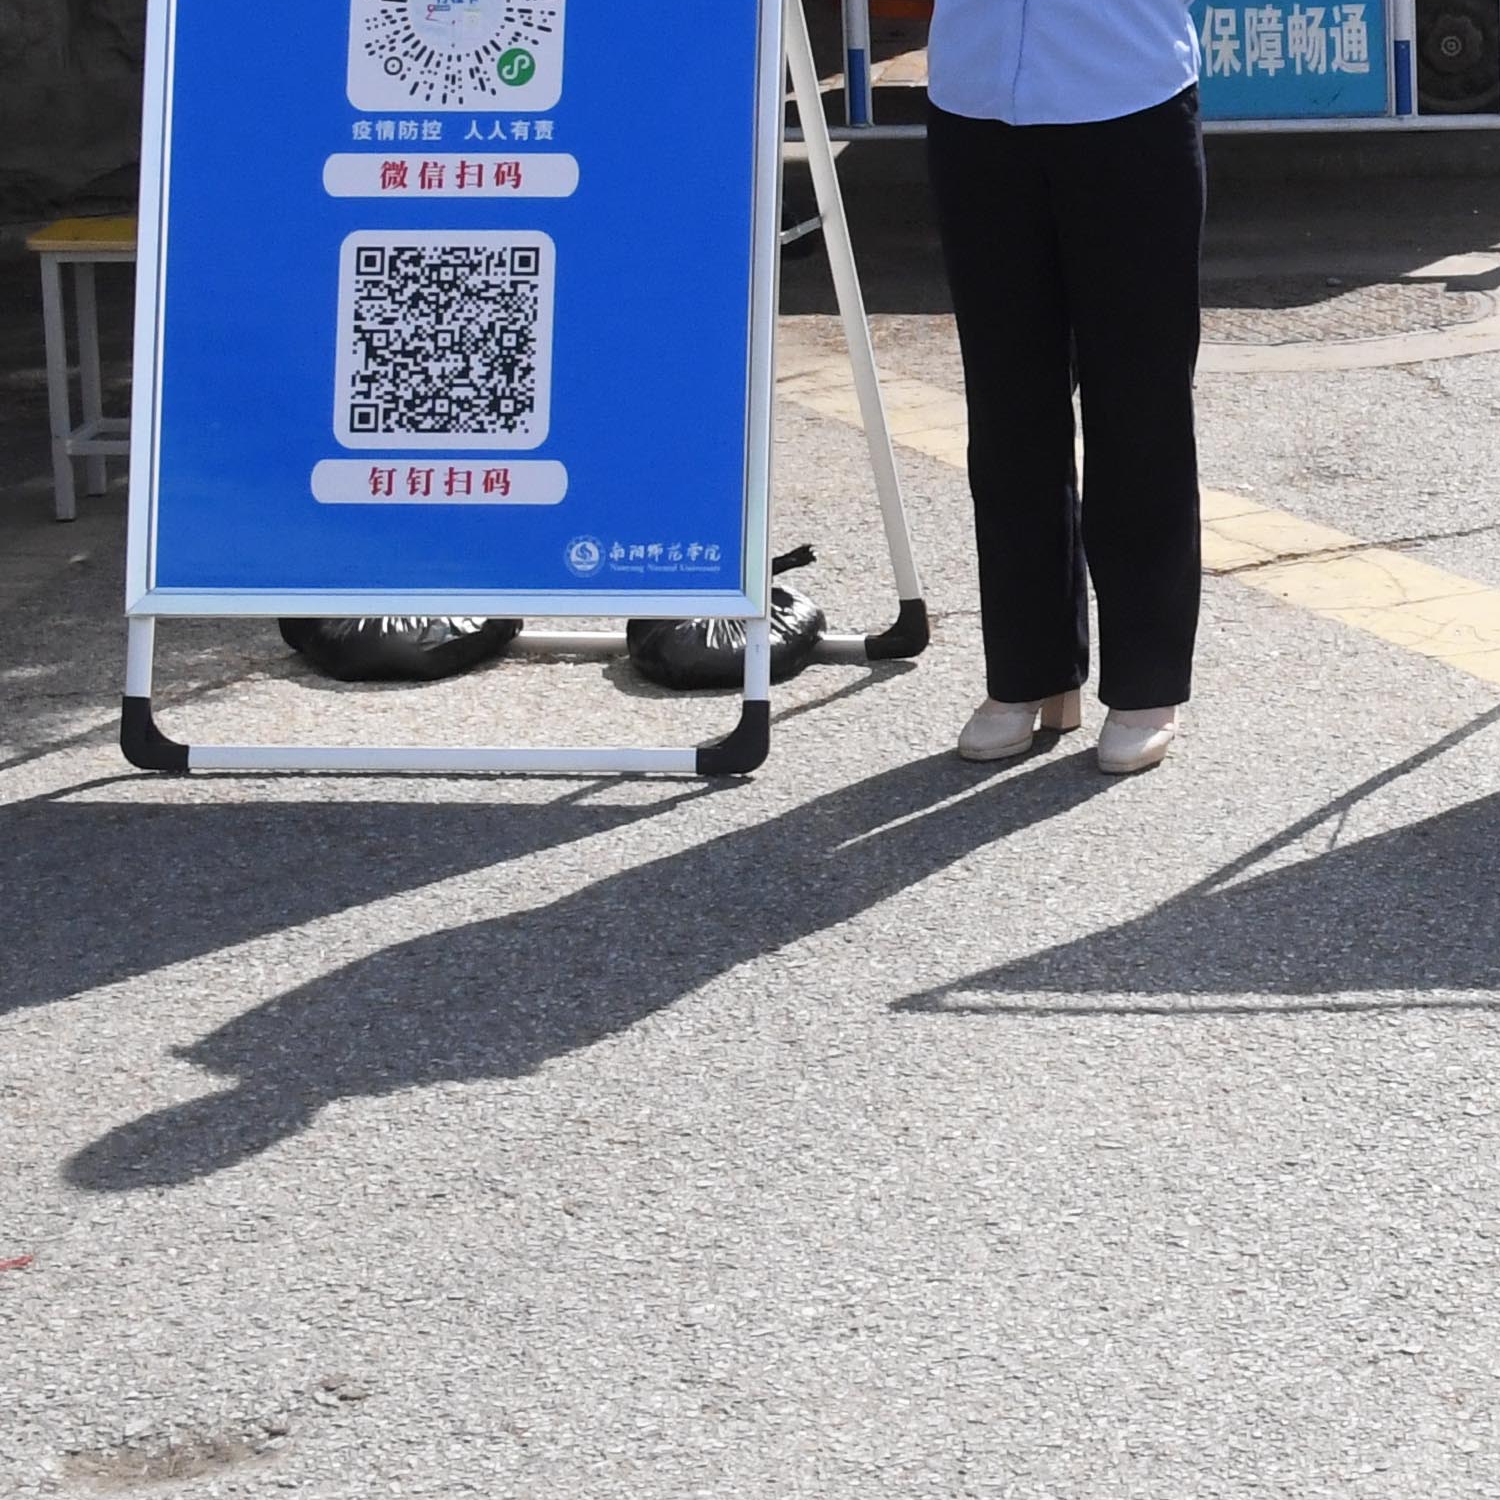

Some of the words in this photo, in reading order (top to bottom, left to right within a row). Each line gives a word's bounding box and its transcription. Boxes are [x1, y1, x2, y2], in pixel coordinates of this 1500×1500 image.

[1201, 2, 1371, 77] 保障畅通
[353, 120, 441, 140] 疫情防控
[465, 121, 552, 140] 人人有责
[378, 160, 522, 189] 微信扫码
[368, 467, 510, 495] 钉钉扫码
[609, 541, 721, 562] 南阳师范学院
